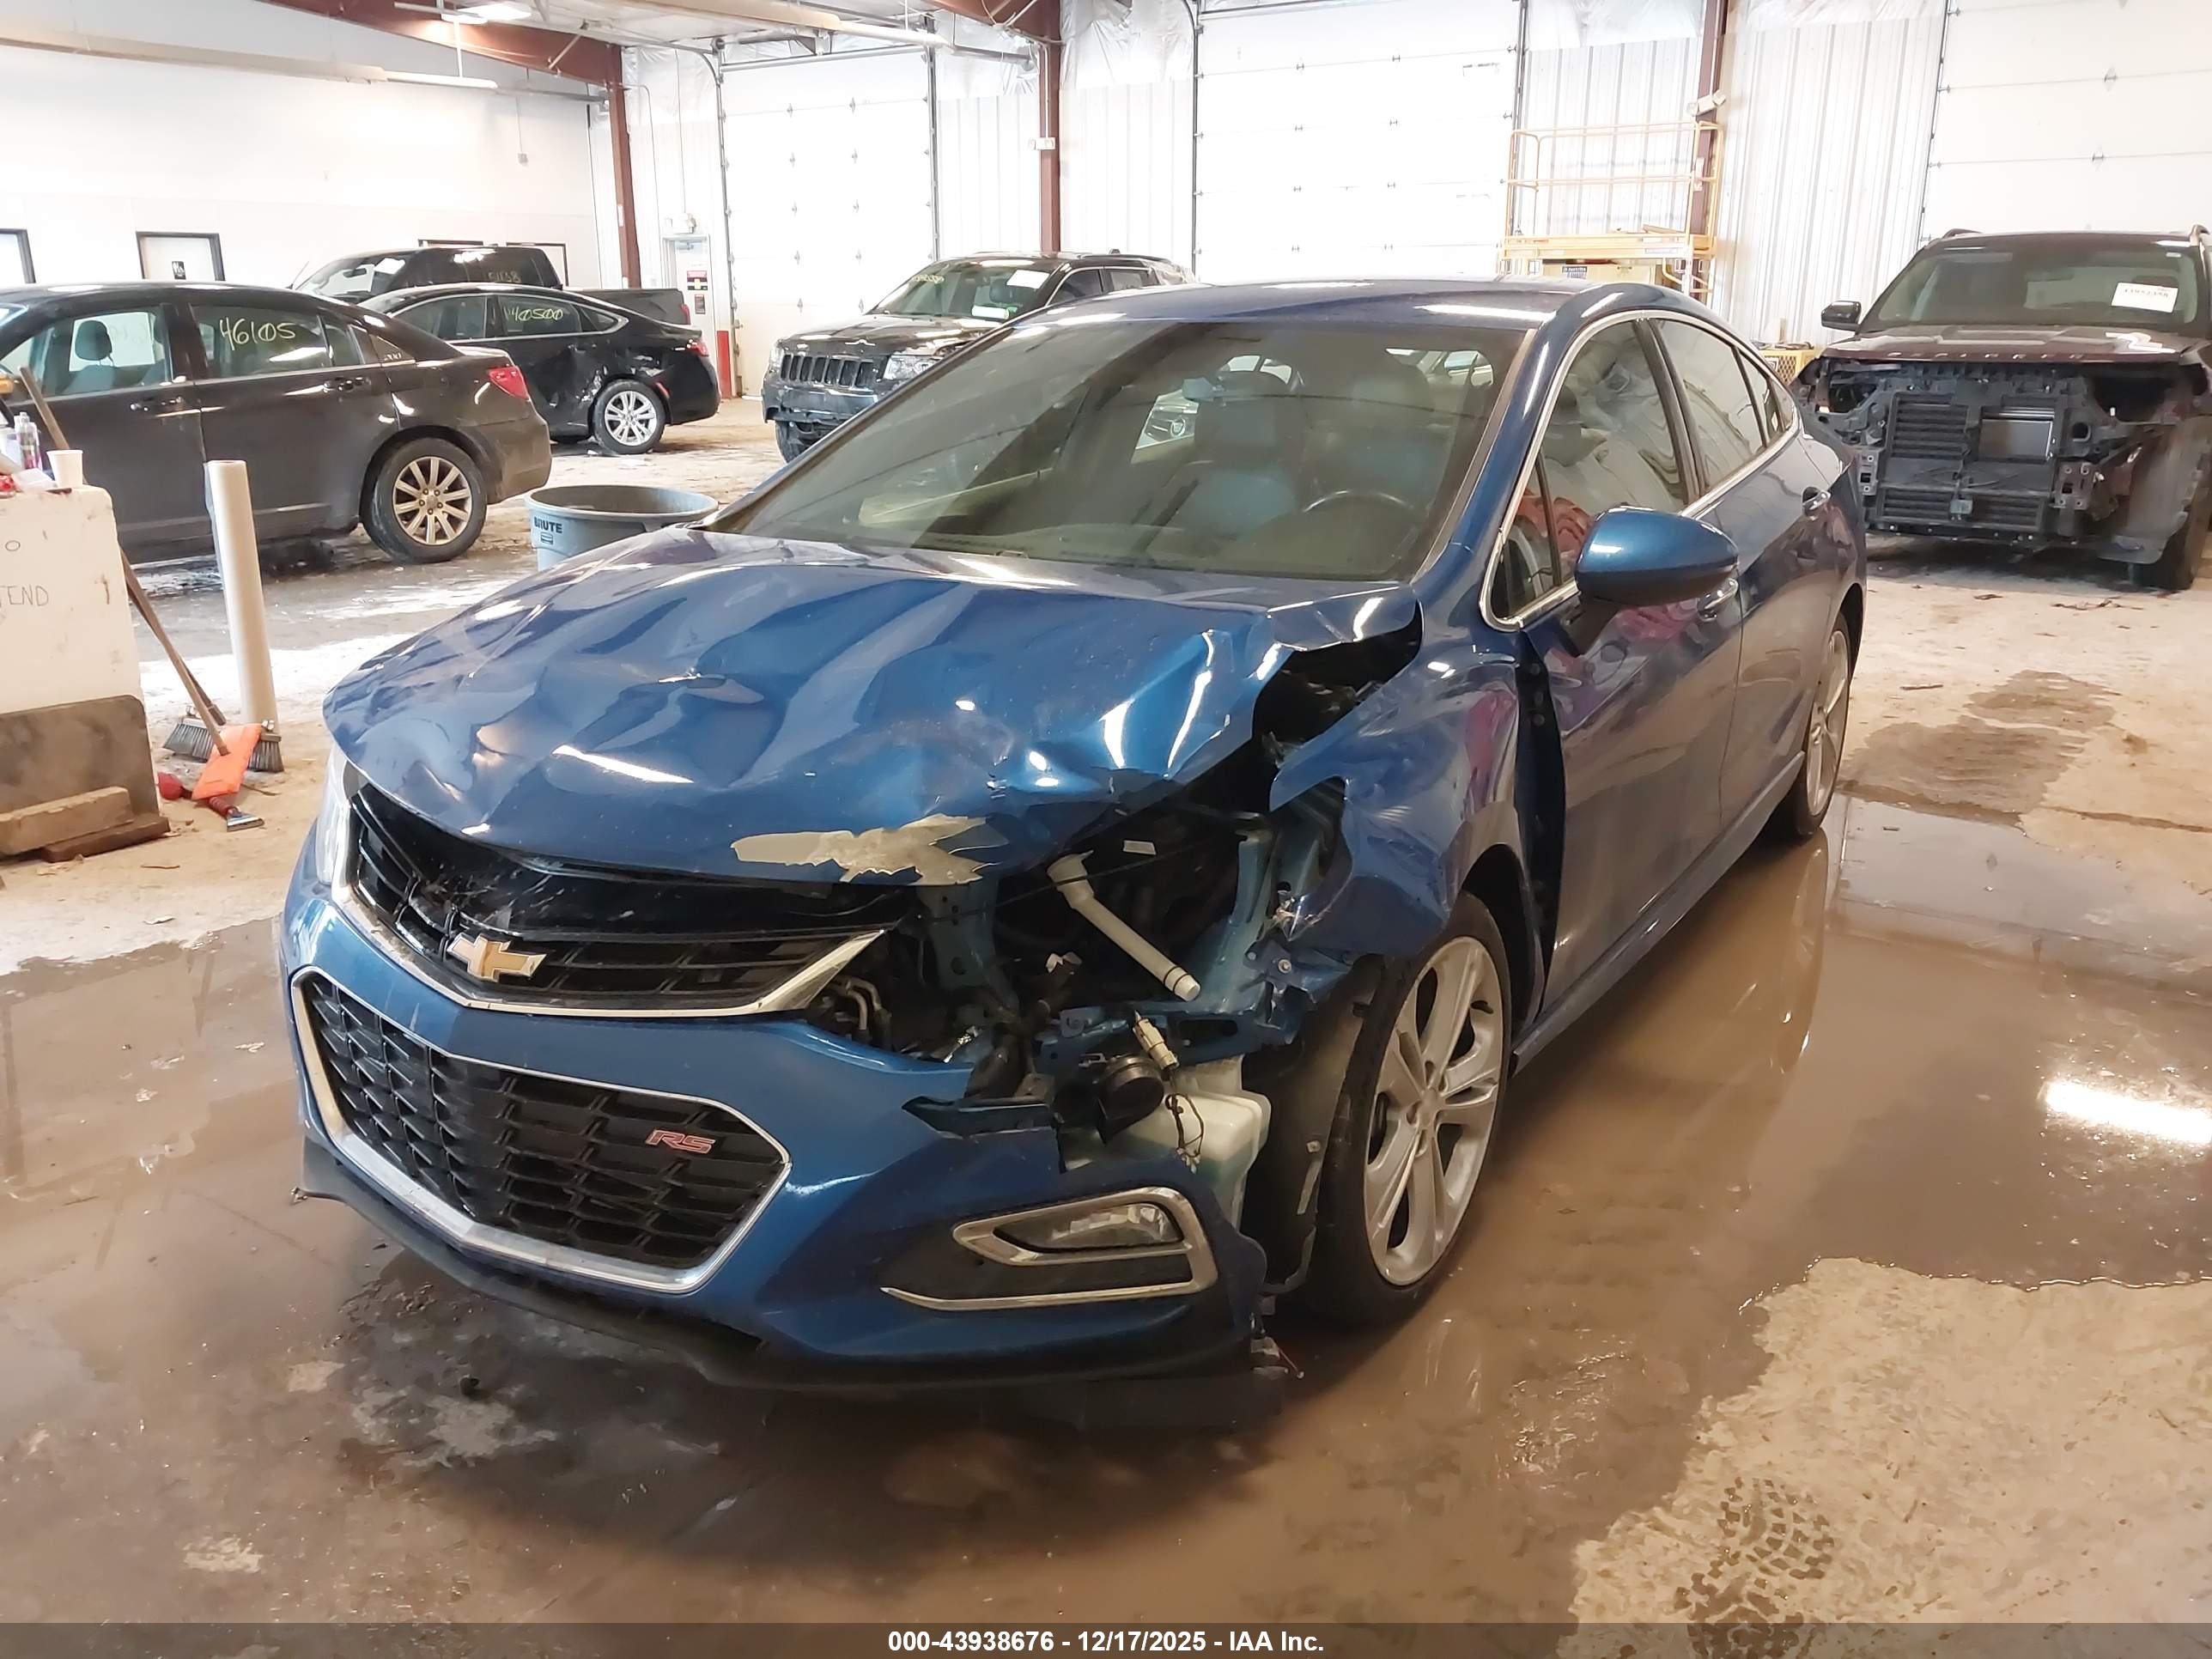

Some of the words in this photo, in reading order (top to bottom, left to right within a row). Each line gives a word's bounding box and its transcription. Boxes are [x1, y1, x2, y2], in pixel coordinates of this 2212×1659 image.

[219, 317, 296, 351] 46105
[533, 516, 562, 533] BRUTE
[646, 1129, 716, 1154] RS
